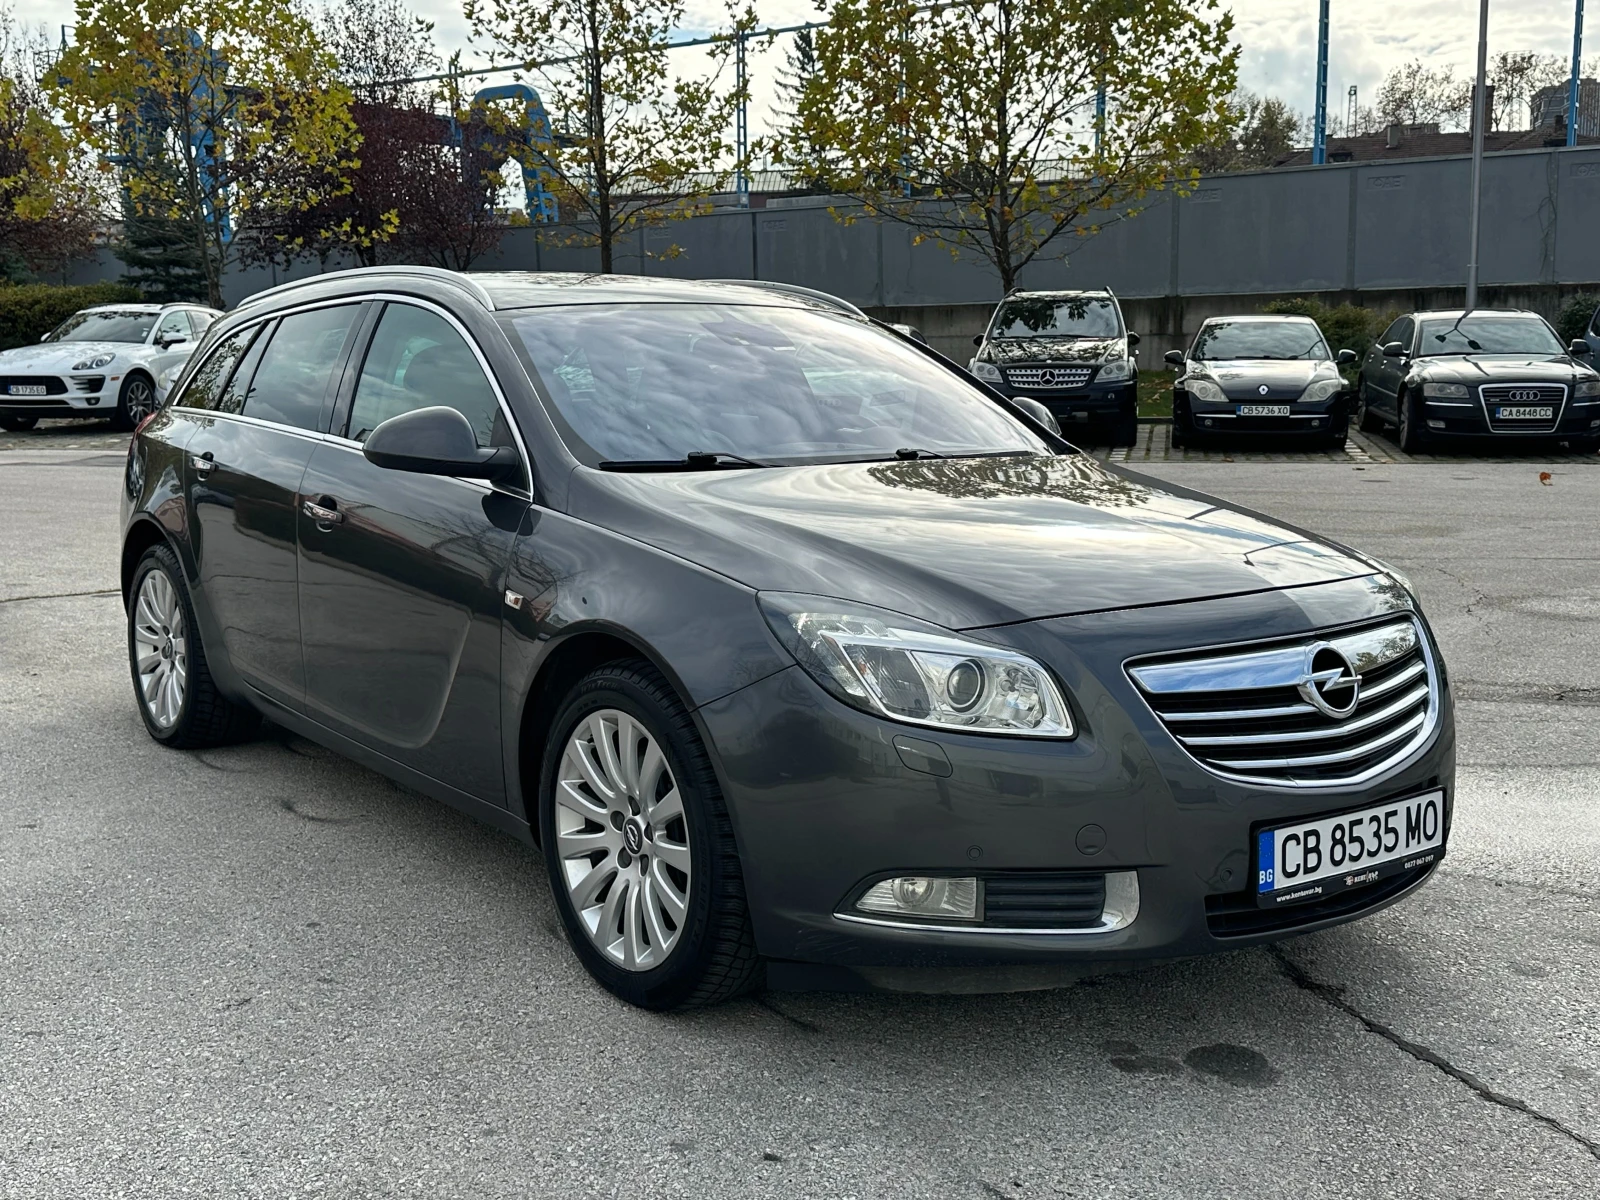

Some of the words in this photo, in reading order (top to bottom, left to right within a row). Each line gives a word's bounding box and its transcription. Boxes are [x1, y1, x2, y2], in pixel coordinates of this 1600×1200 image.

[1242, 406, 1254, 415] CB
[1254, 406, 1276, 415] 5736
[1501, 408, 1514, 418] CA
[1515, 408, 1538, 417] 8448
[1538, 408, 1551, 417] CC
[1281, 829, 1322, 879] CB
[1329, 809, 1399, 867] 8535
[1405, 800, 1438, 849] MO
[1259, 868, 1273, 885] BG
